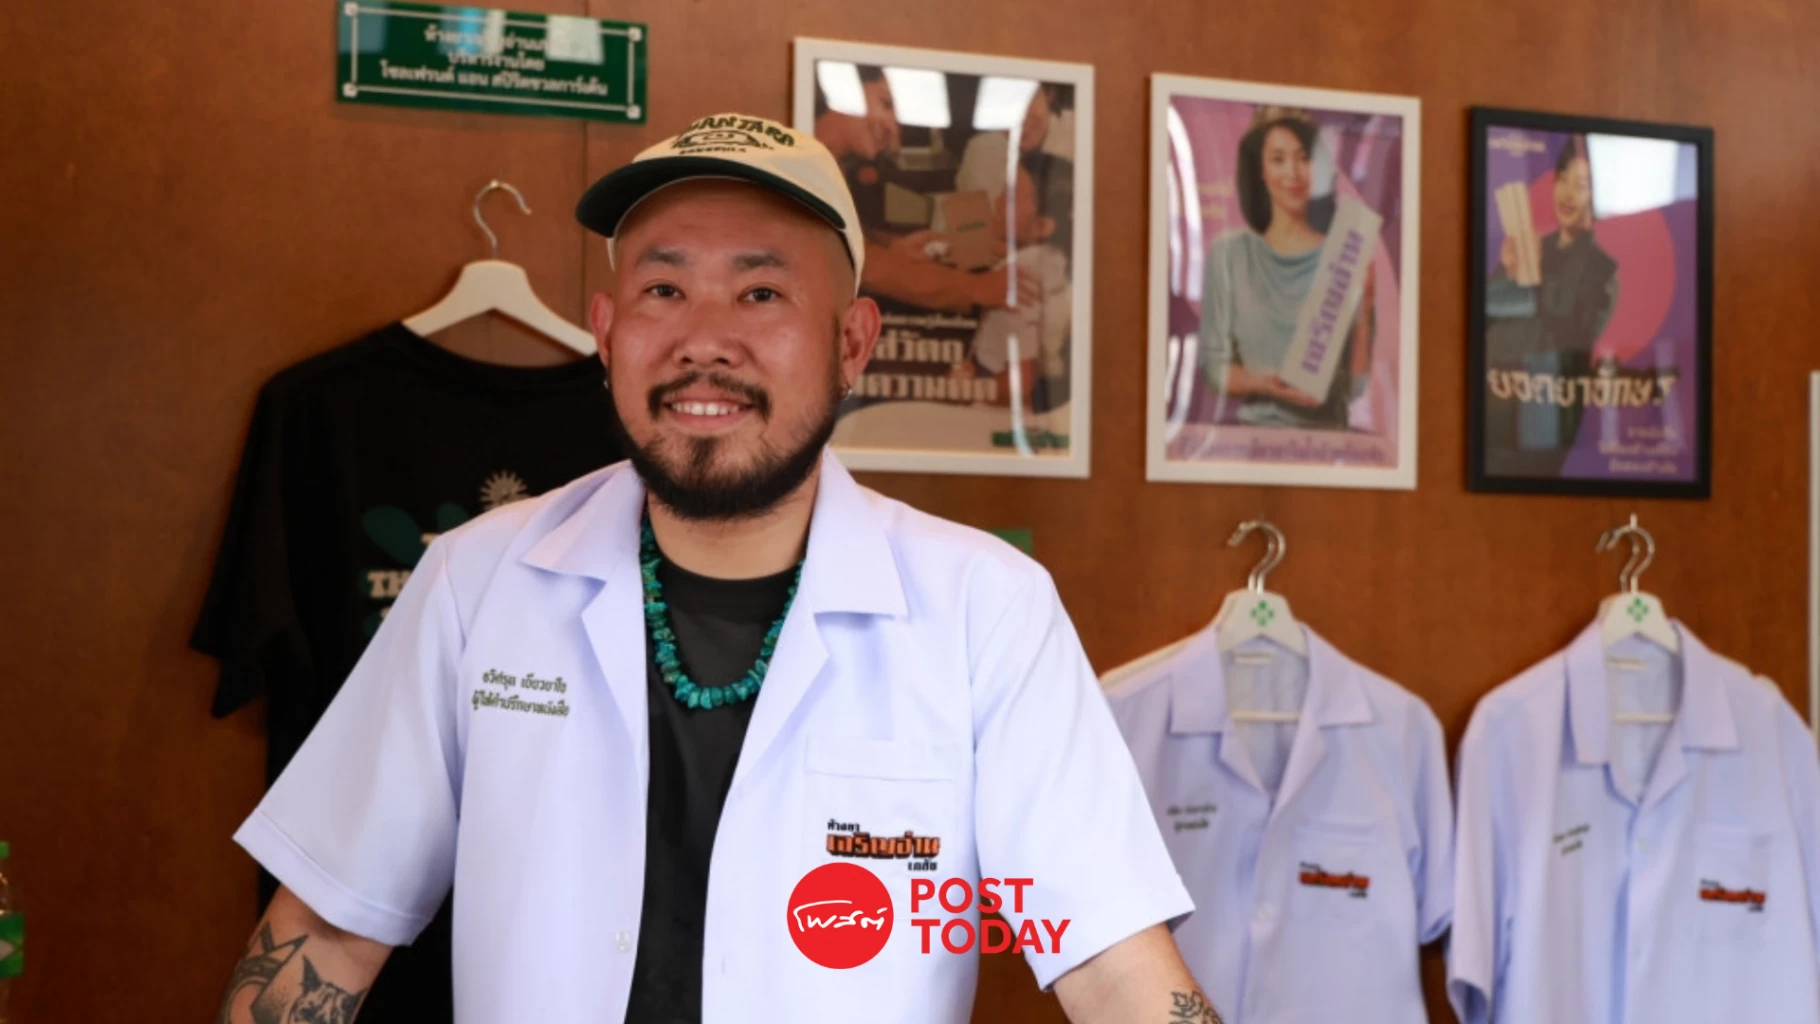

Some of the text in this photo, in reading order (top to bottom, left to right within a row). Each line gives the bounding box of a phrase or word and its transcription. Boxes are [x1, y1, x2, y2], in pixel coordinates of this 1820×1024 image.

[827, 819, 860, 833] ห้างยา
[826, 830, 941, 859] เจริญอ่าน
